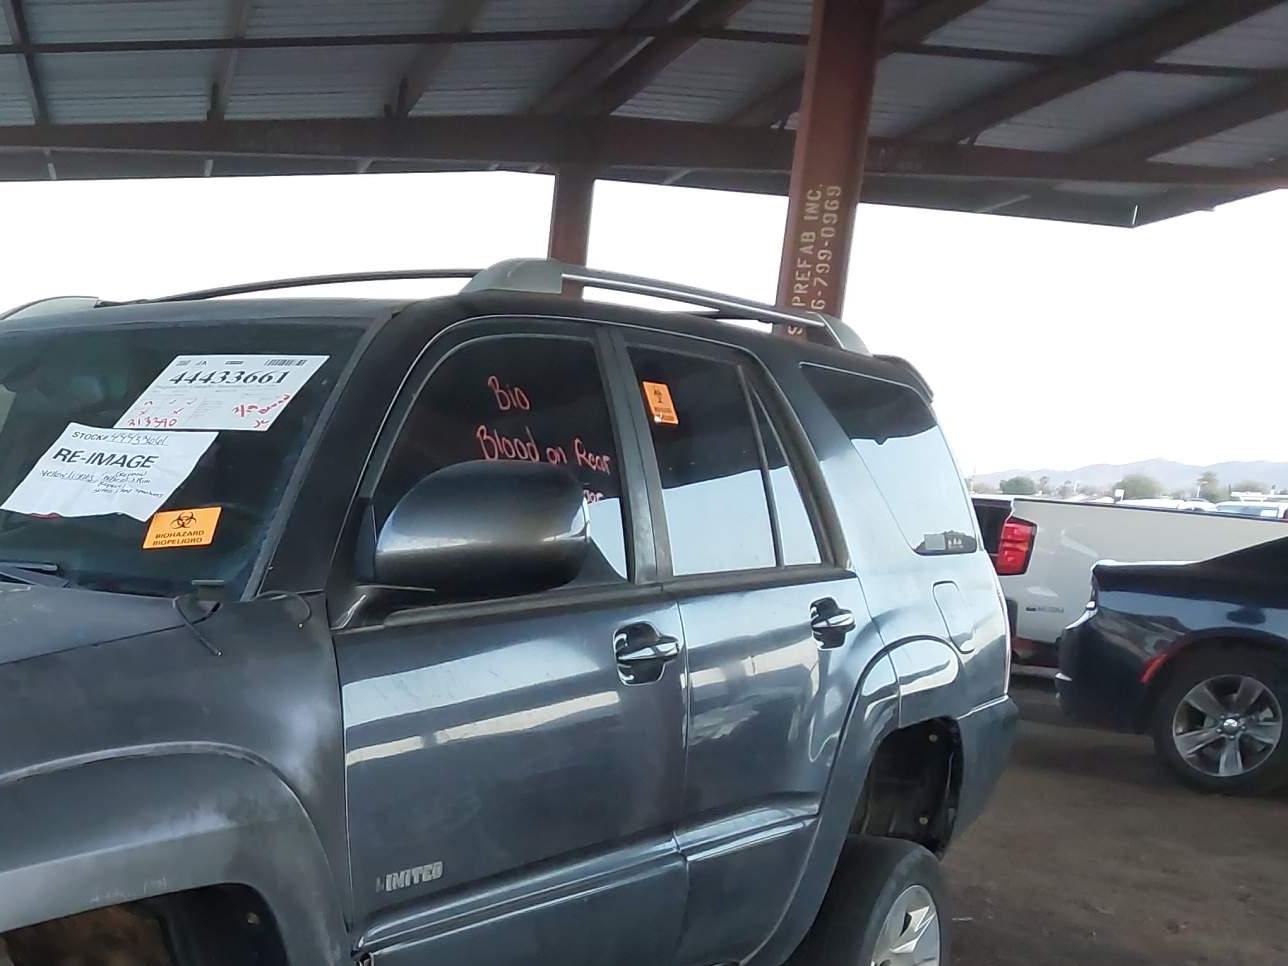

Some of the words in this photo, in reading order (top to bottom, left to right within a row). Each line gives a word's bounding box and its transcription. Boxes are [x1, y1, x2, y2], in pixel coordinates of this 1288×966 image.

[803, 184, 823, 221] INC.
[811, 185, 842, 310] 6-799-0969
[792, 231, 816, 307] PREFAB
[169, 370, 291, 385] 44433661
[488, 375, 531, 411] Bio
[52, 448, 159, 468] RE-IMAGE
[476, 425, 540, 463] Blood
[546, 445, 568, 465] on
[152, 537, 203, 546] BIOPELIGRO
[155, 530, 205, 539] BIOHAZARD
